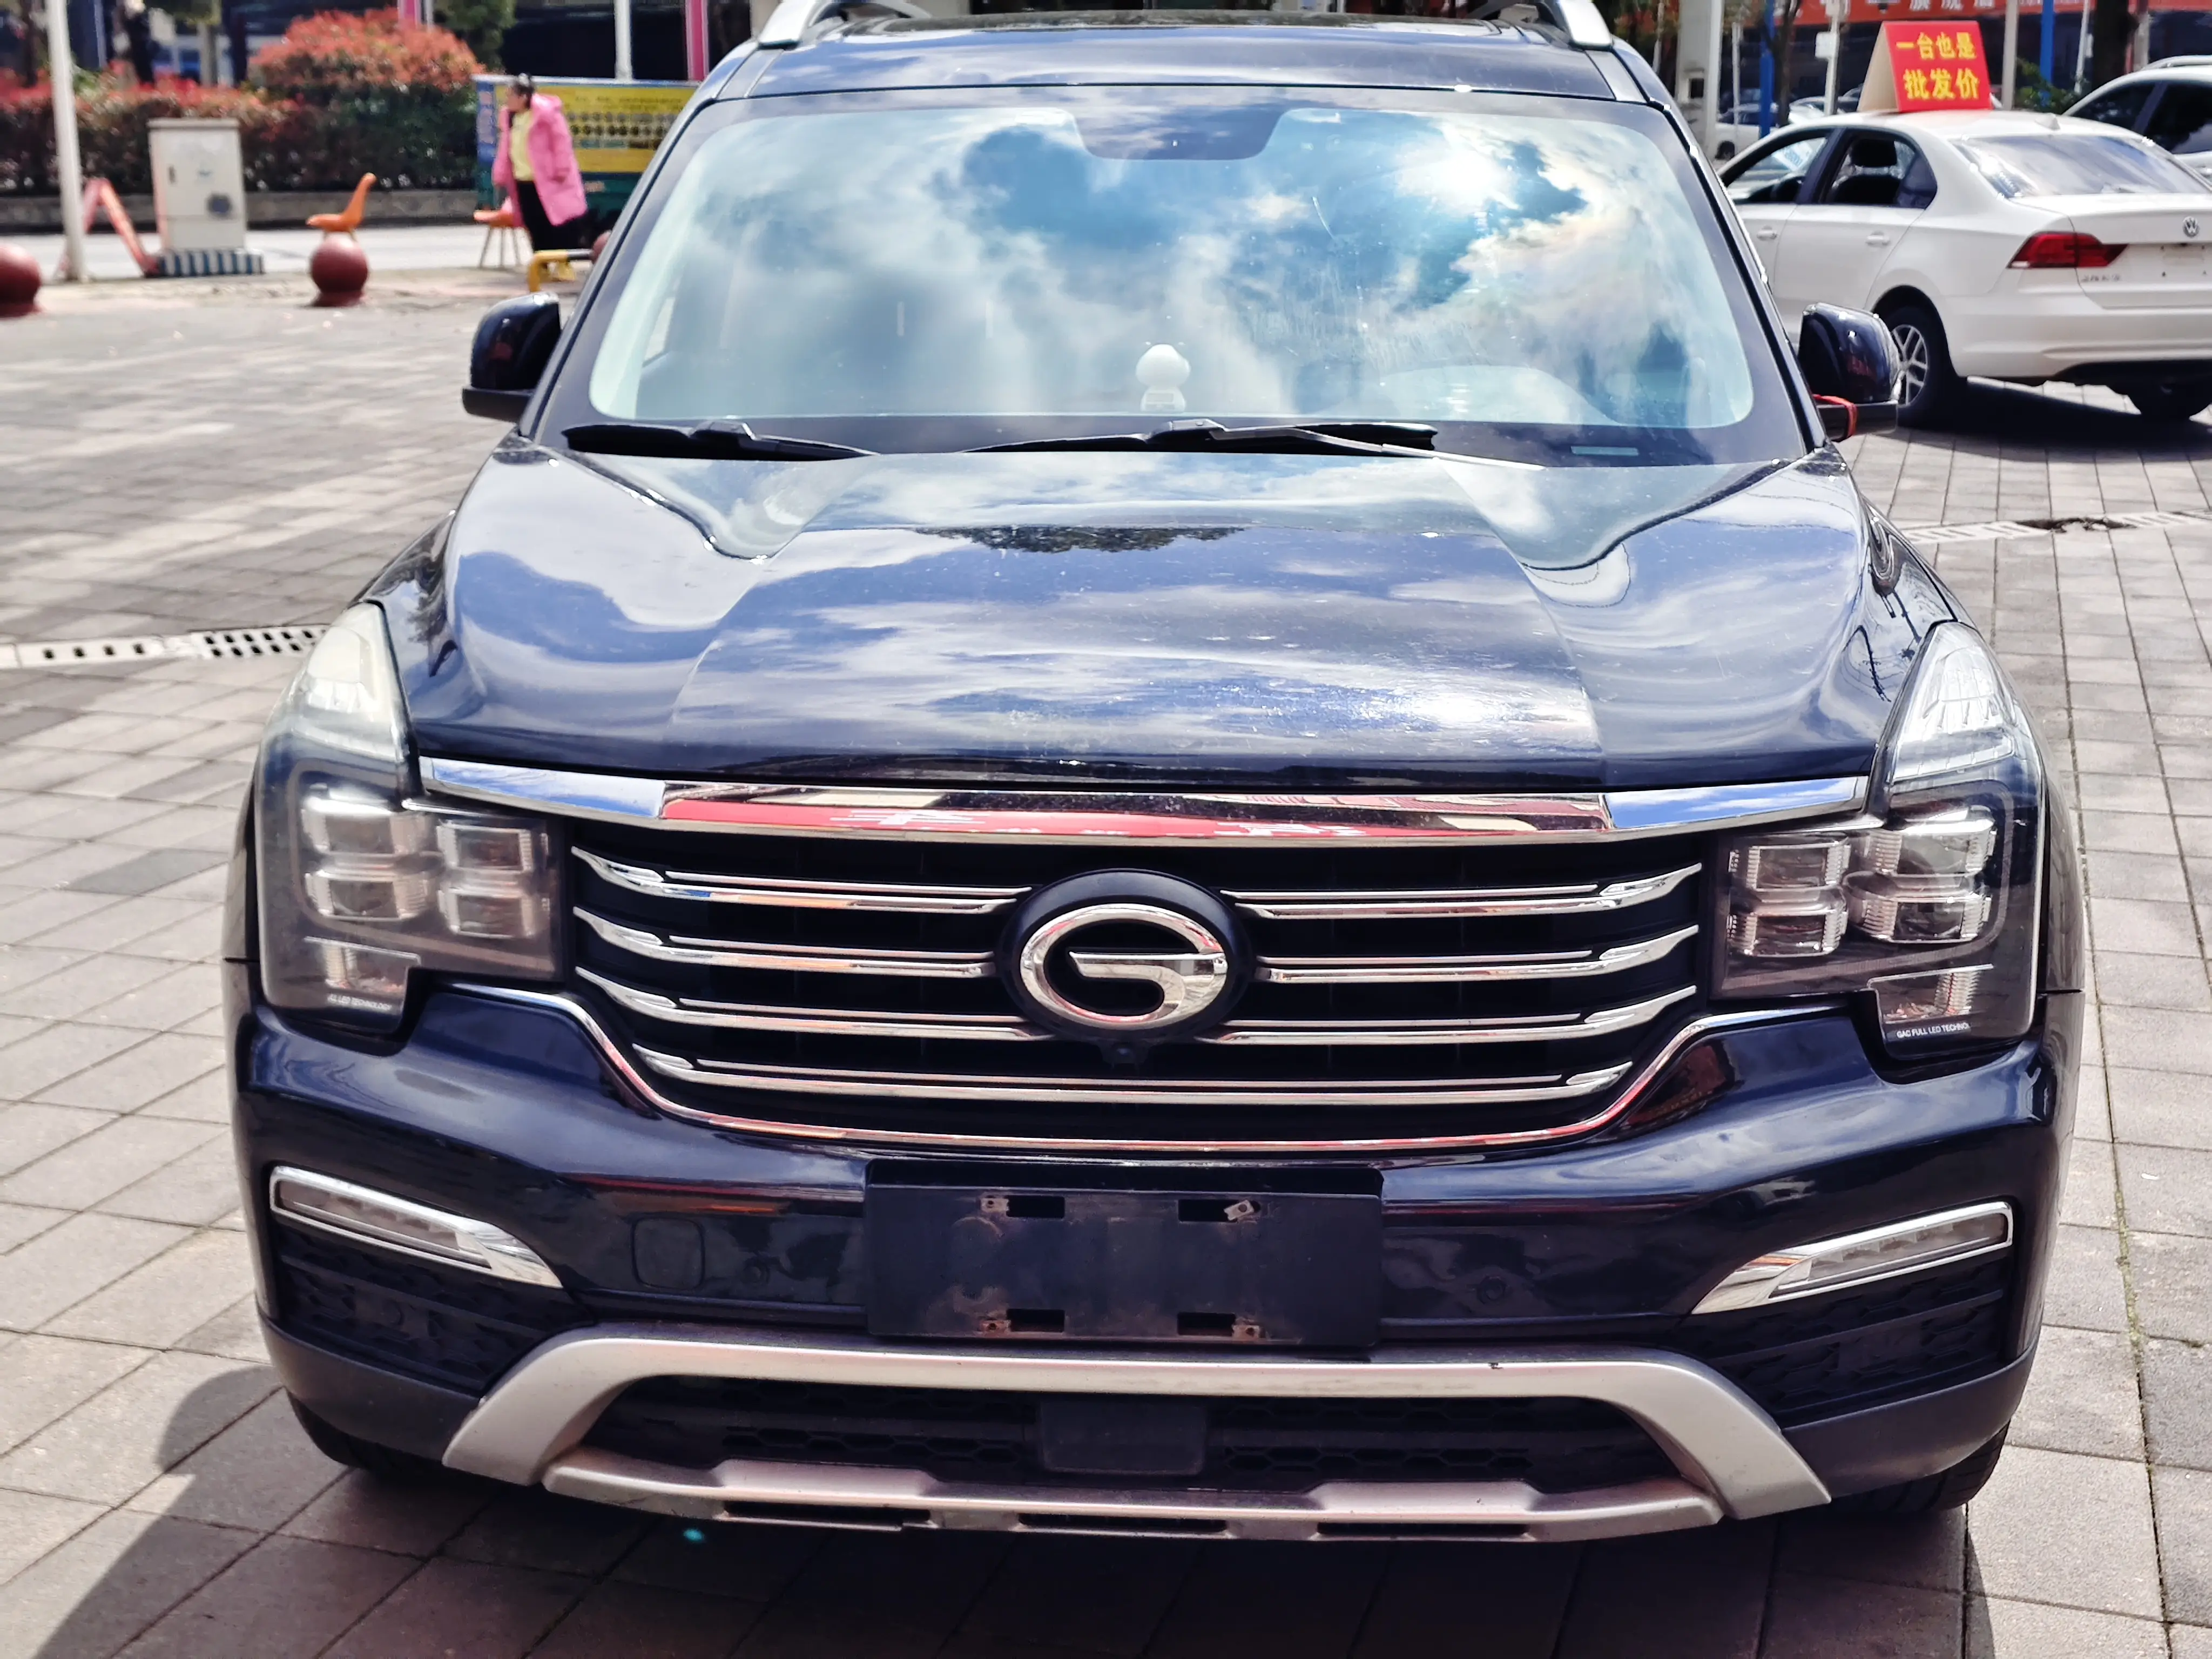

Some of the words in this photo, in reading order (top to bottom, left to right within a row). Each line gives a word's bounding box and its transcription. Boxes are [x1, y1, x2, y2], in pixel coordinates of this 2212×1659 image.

[1896, 31, 1977, 60] 一台也是
[1903, 68, 1980, 100] 批发价
[1896, 1029, 1911, 1038] GAC
[1911, 1027, 1928, 1036] FULL
[1928, 1025, 1942, 1034] LED
